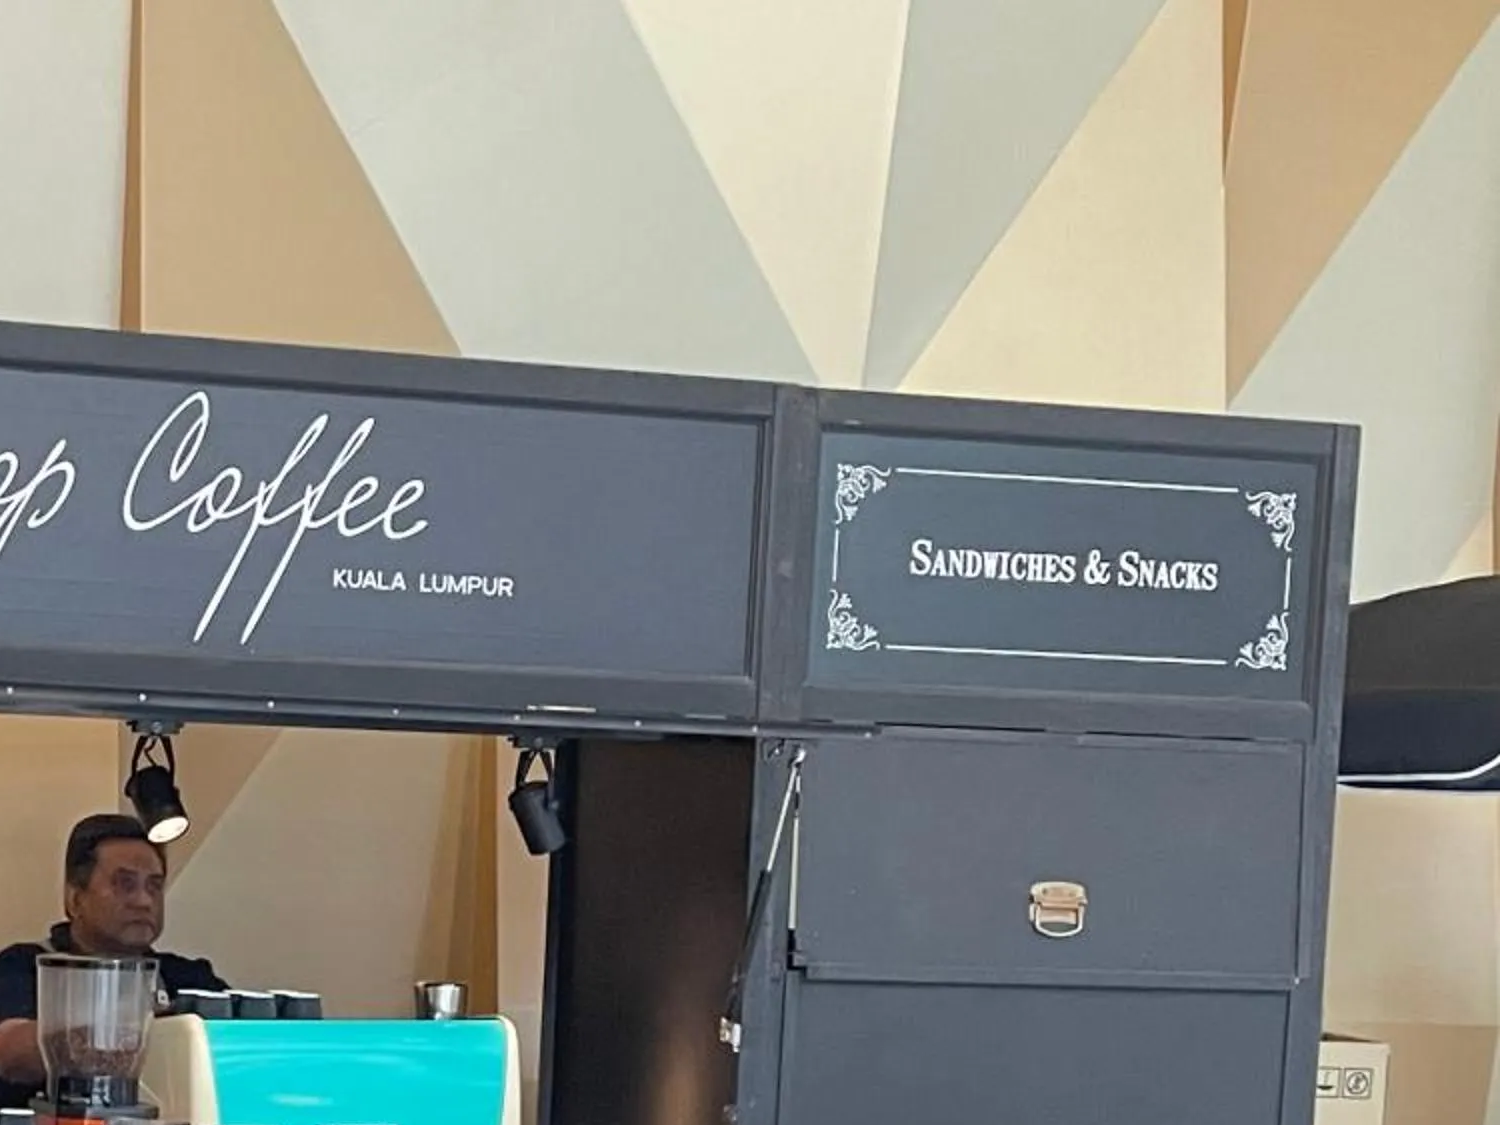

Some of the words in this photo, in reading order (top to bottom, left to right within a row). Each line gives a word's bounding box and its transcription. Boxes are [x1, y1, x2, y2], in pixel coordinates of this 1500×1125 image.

[122, 391, 428, 644] Coffee
[332, 568, 406, 592] KUALA
[419, 573, 514, 597] LUMPUR
[910, 539, 1076, 584] SANDWICHES
[1083, 549, 1111, 585] &
[1117, 551, 1218, 591] SNACKS
